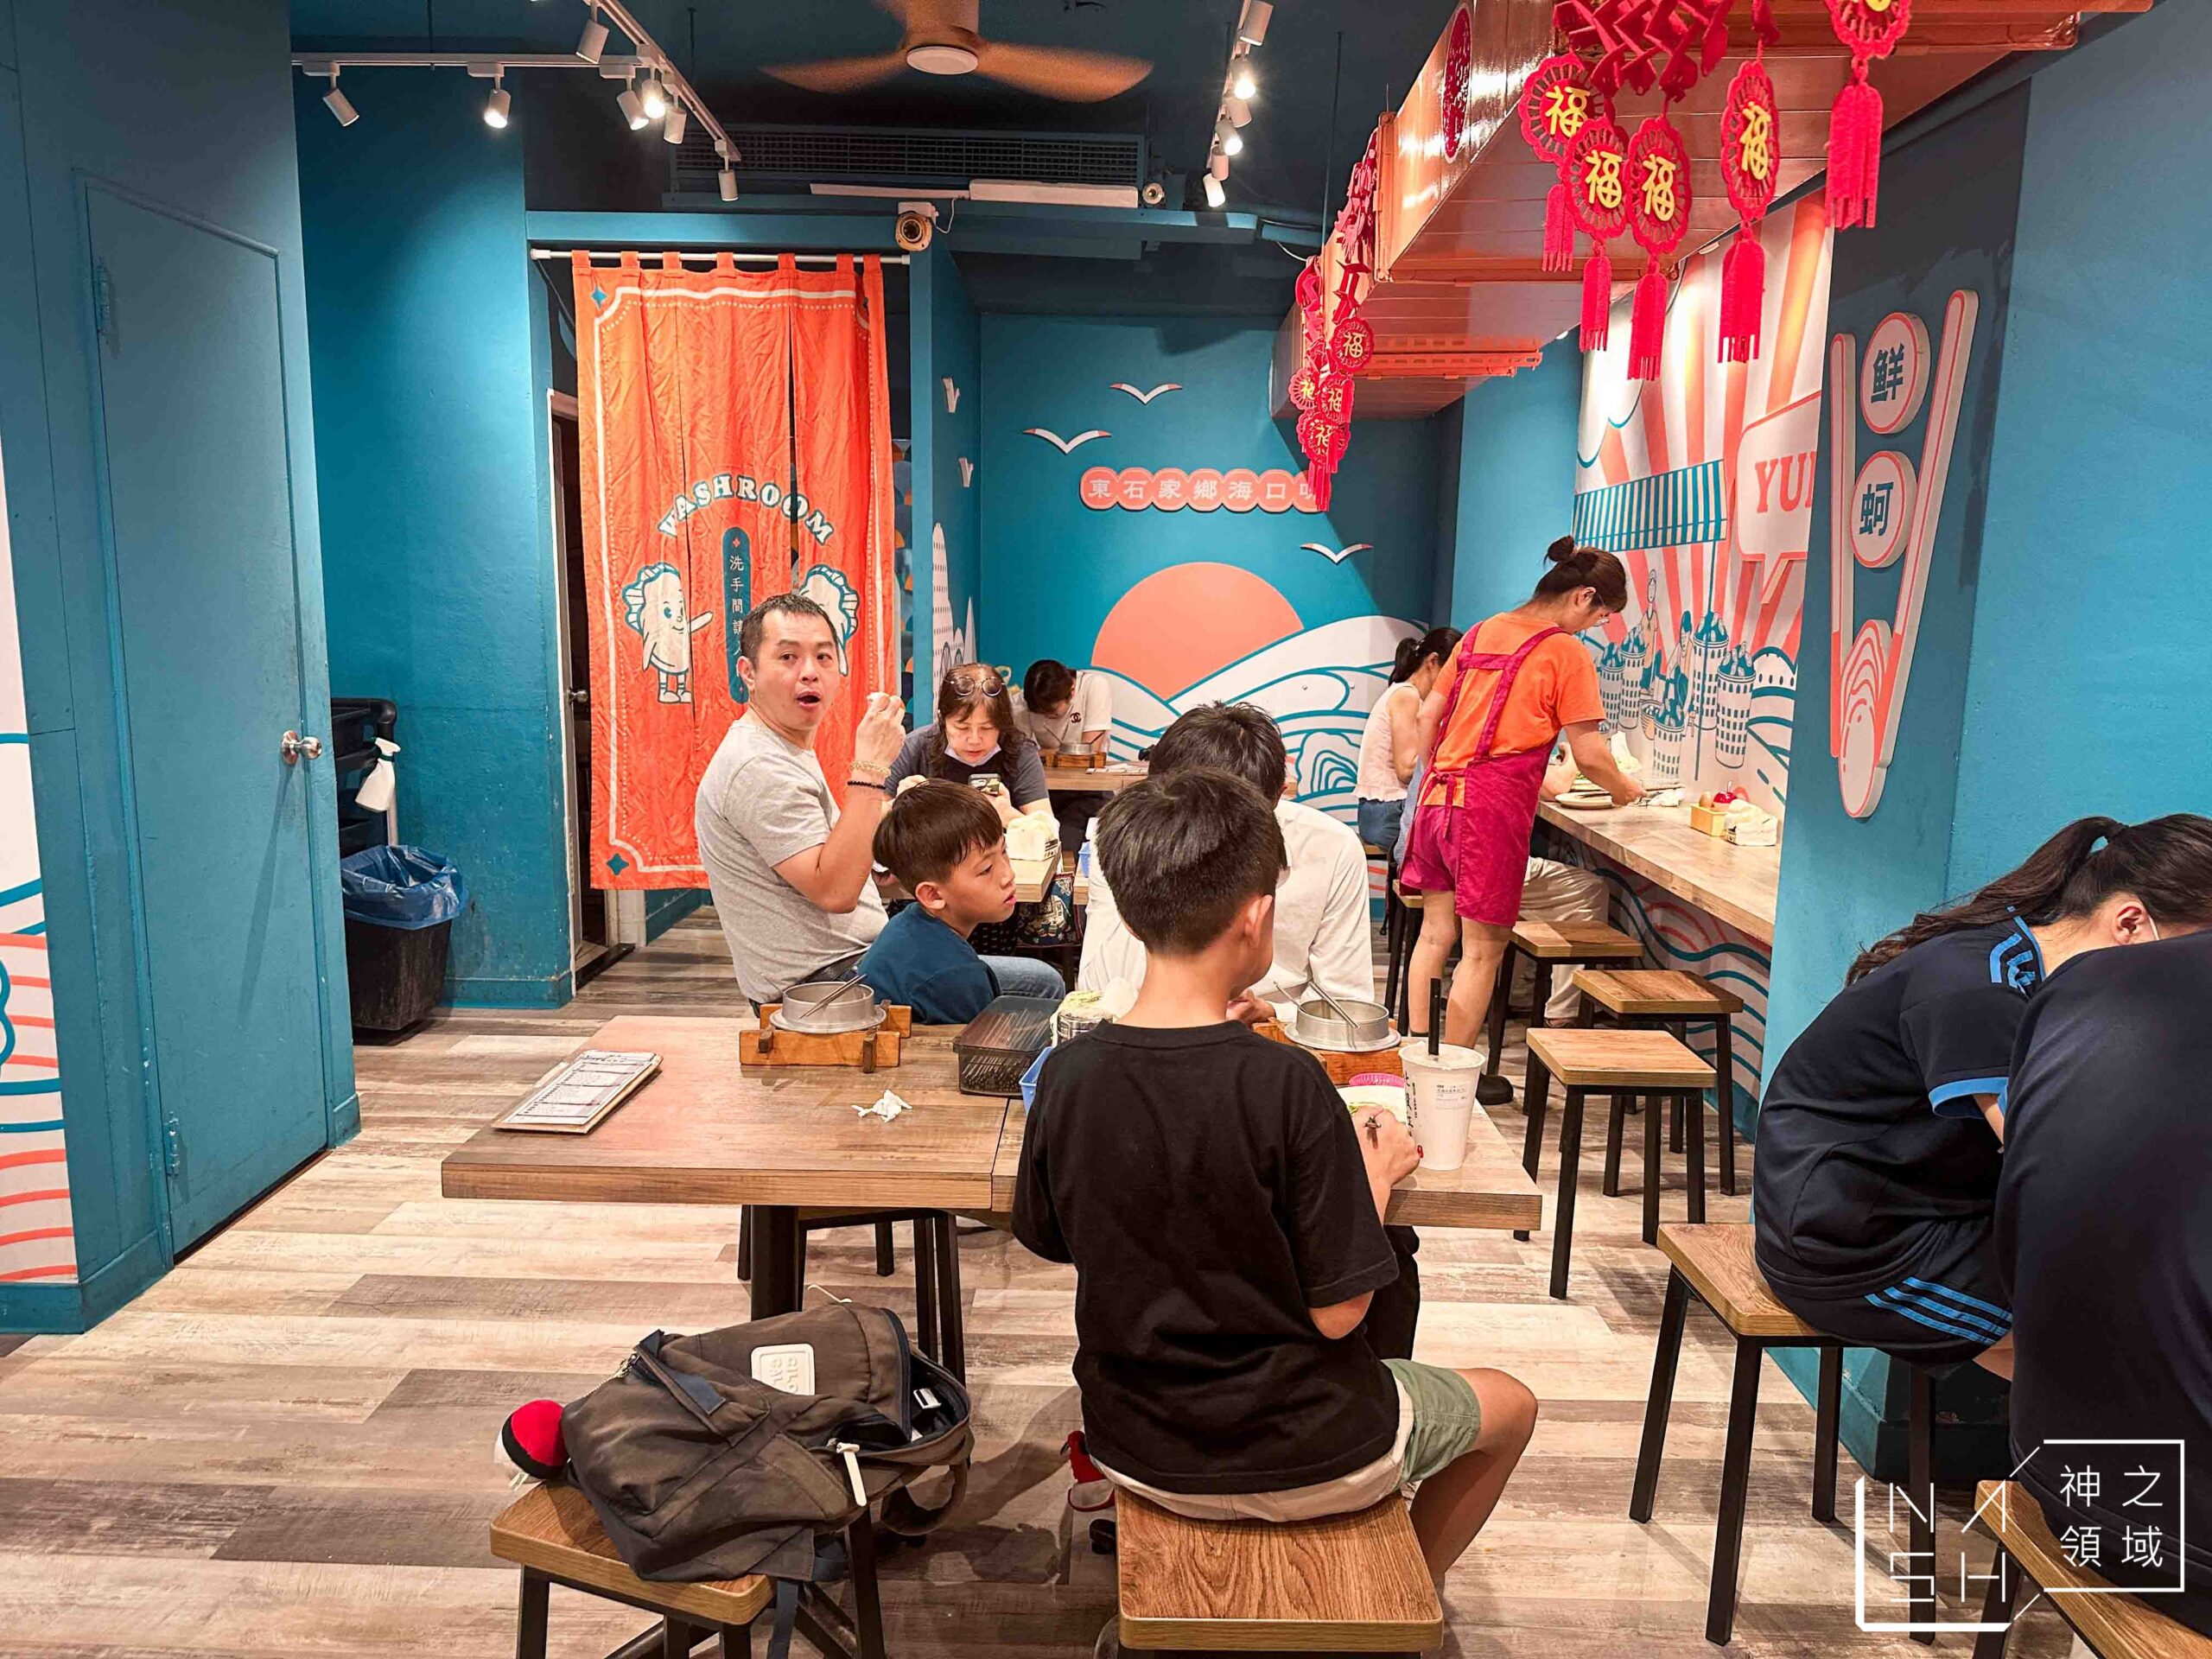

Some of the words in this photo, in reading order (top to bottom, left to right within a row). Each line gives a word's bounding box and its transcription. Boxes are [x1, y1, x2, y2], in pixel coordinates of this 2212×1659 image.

[1545, 86, 1590, 137] 福
[1739, 101, 1771, 180] 福
[1586, 149, 1623, 208] 福
[1642, 154, 1676, 221] 福
[1343, 331, 1364, 358] 福
[1089, 478, 1316, 500] 東石家鄉海口
